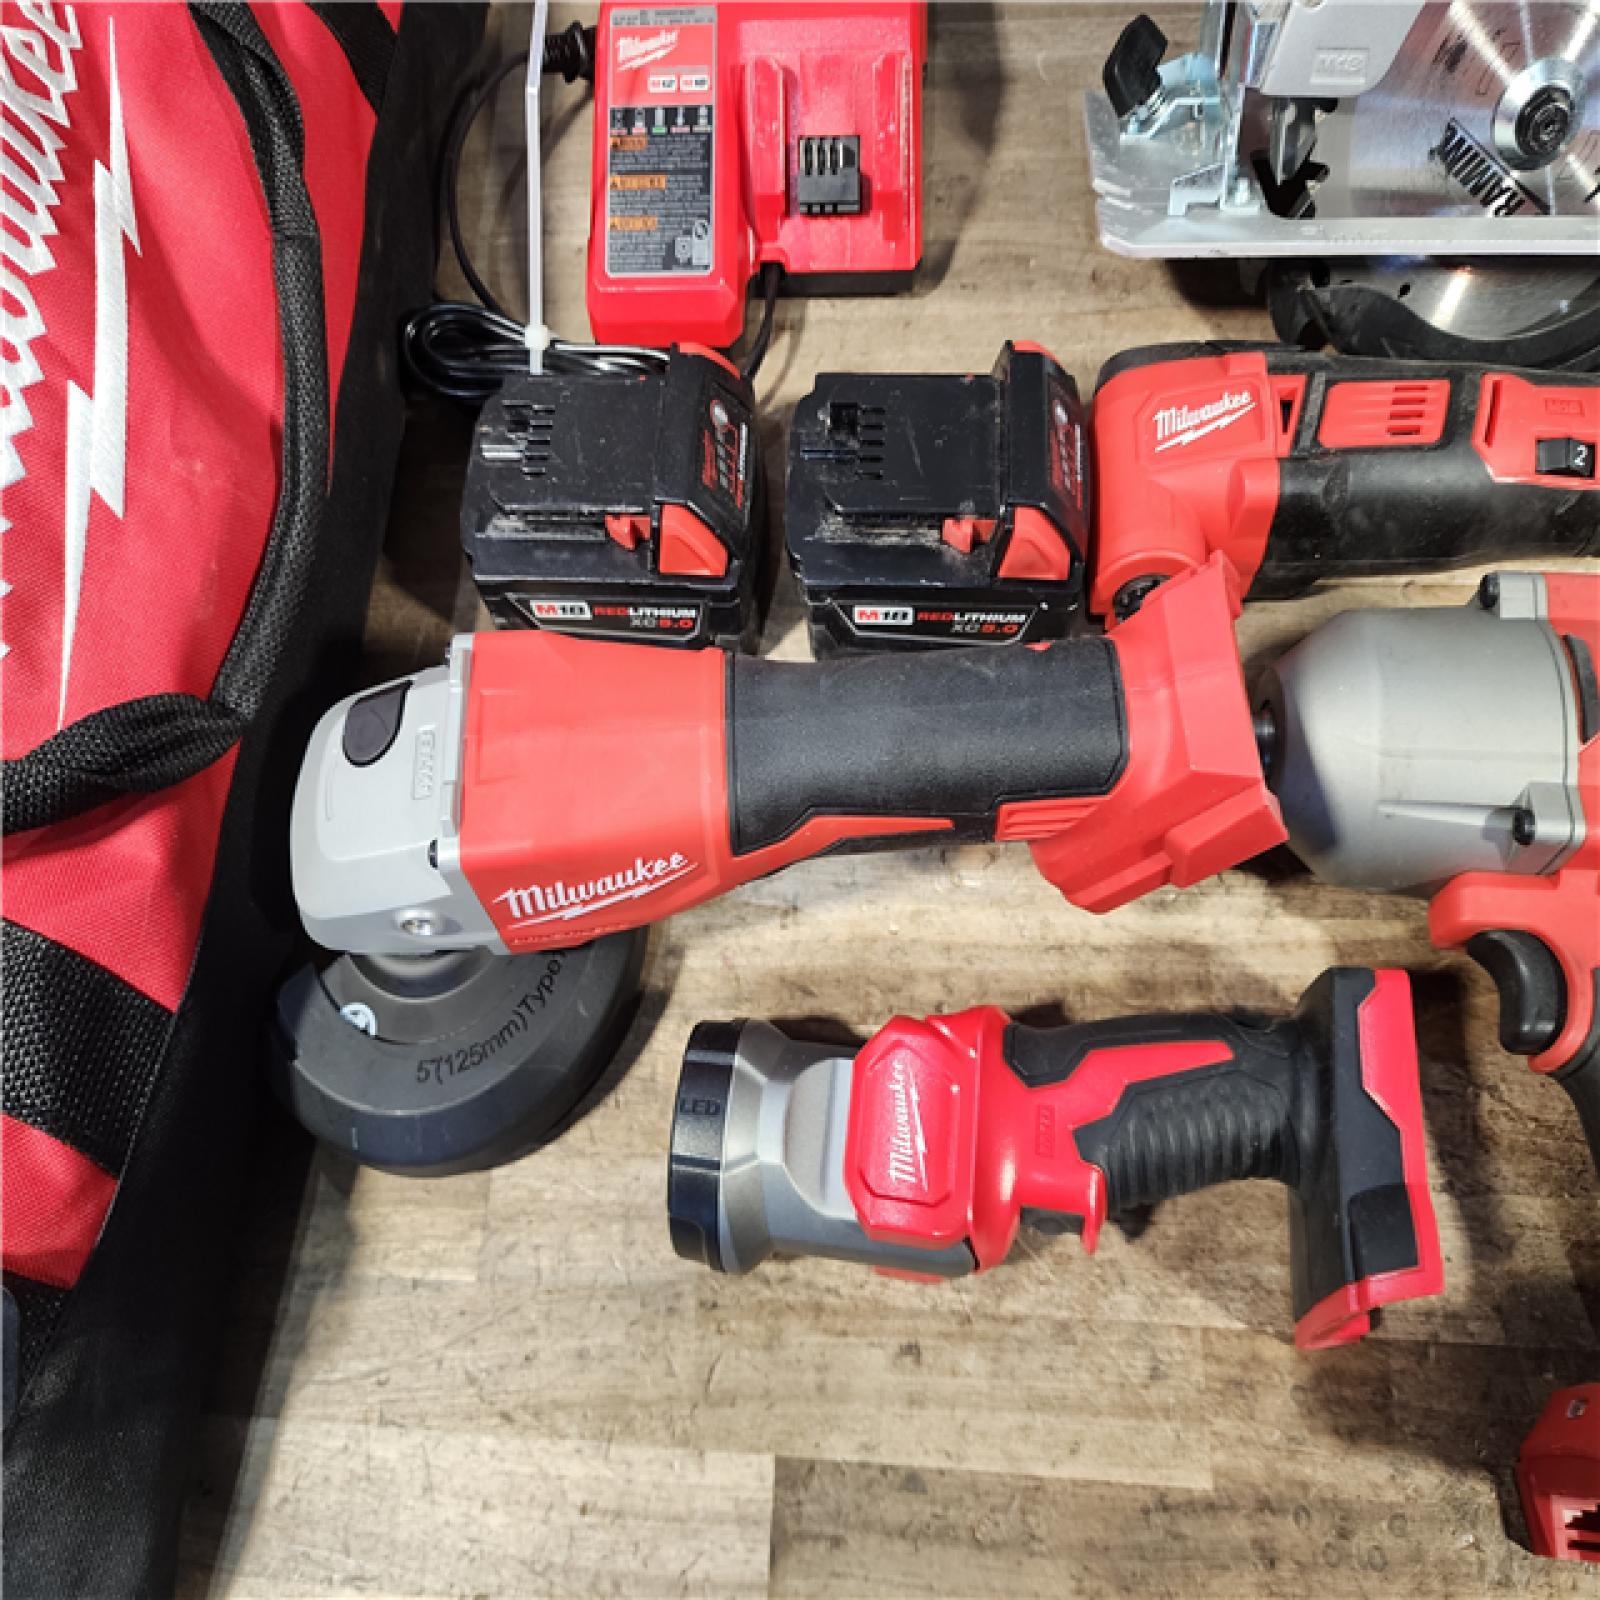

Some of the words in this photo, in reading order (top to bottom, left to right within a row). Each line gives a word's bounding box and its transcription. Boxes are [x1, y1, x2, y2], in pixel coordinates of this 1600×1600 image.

[1152, 391, 1252, 440] Milwaukee
[1574, 445, 1588, 466] 2
[857, 609, 909, 621] M18
[917, 611, 1026, 623] REDLITHIUM
[491, 852, 689, 919] Milwaukee
[888, 1059, 917, 1184] Milwaukee
